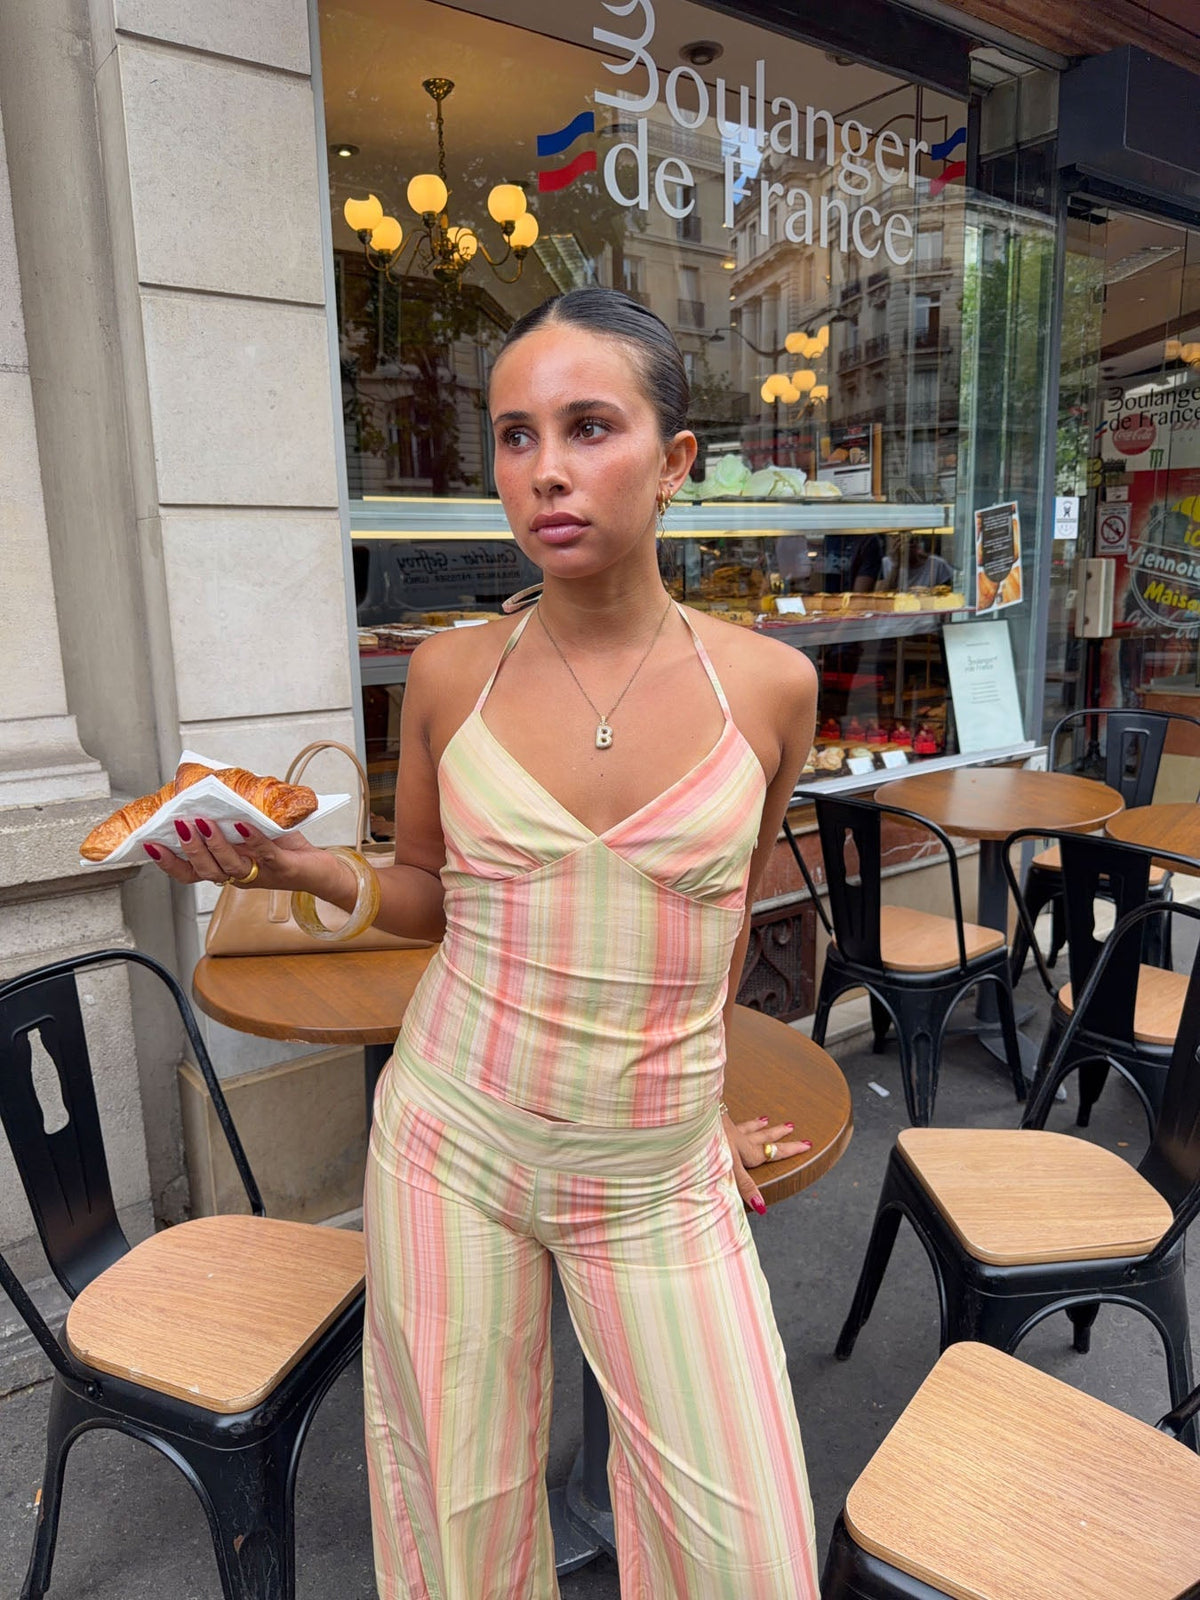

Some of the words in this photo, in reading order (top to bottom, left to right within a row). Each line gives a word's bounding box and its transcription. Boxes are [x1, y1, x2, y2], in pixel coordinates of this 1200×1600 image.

[593, 0, 928, 196] Boulanger
[603, 118, 695, 219] de
[723, 144, 914, 265] France
[1109, 412, 1132, 432] de
[1143, 580, 1200, 614] Maiso
[595, 725, 614, 751] B
